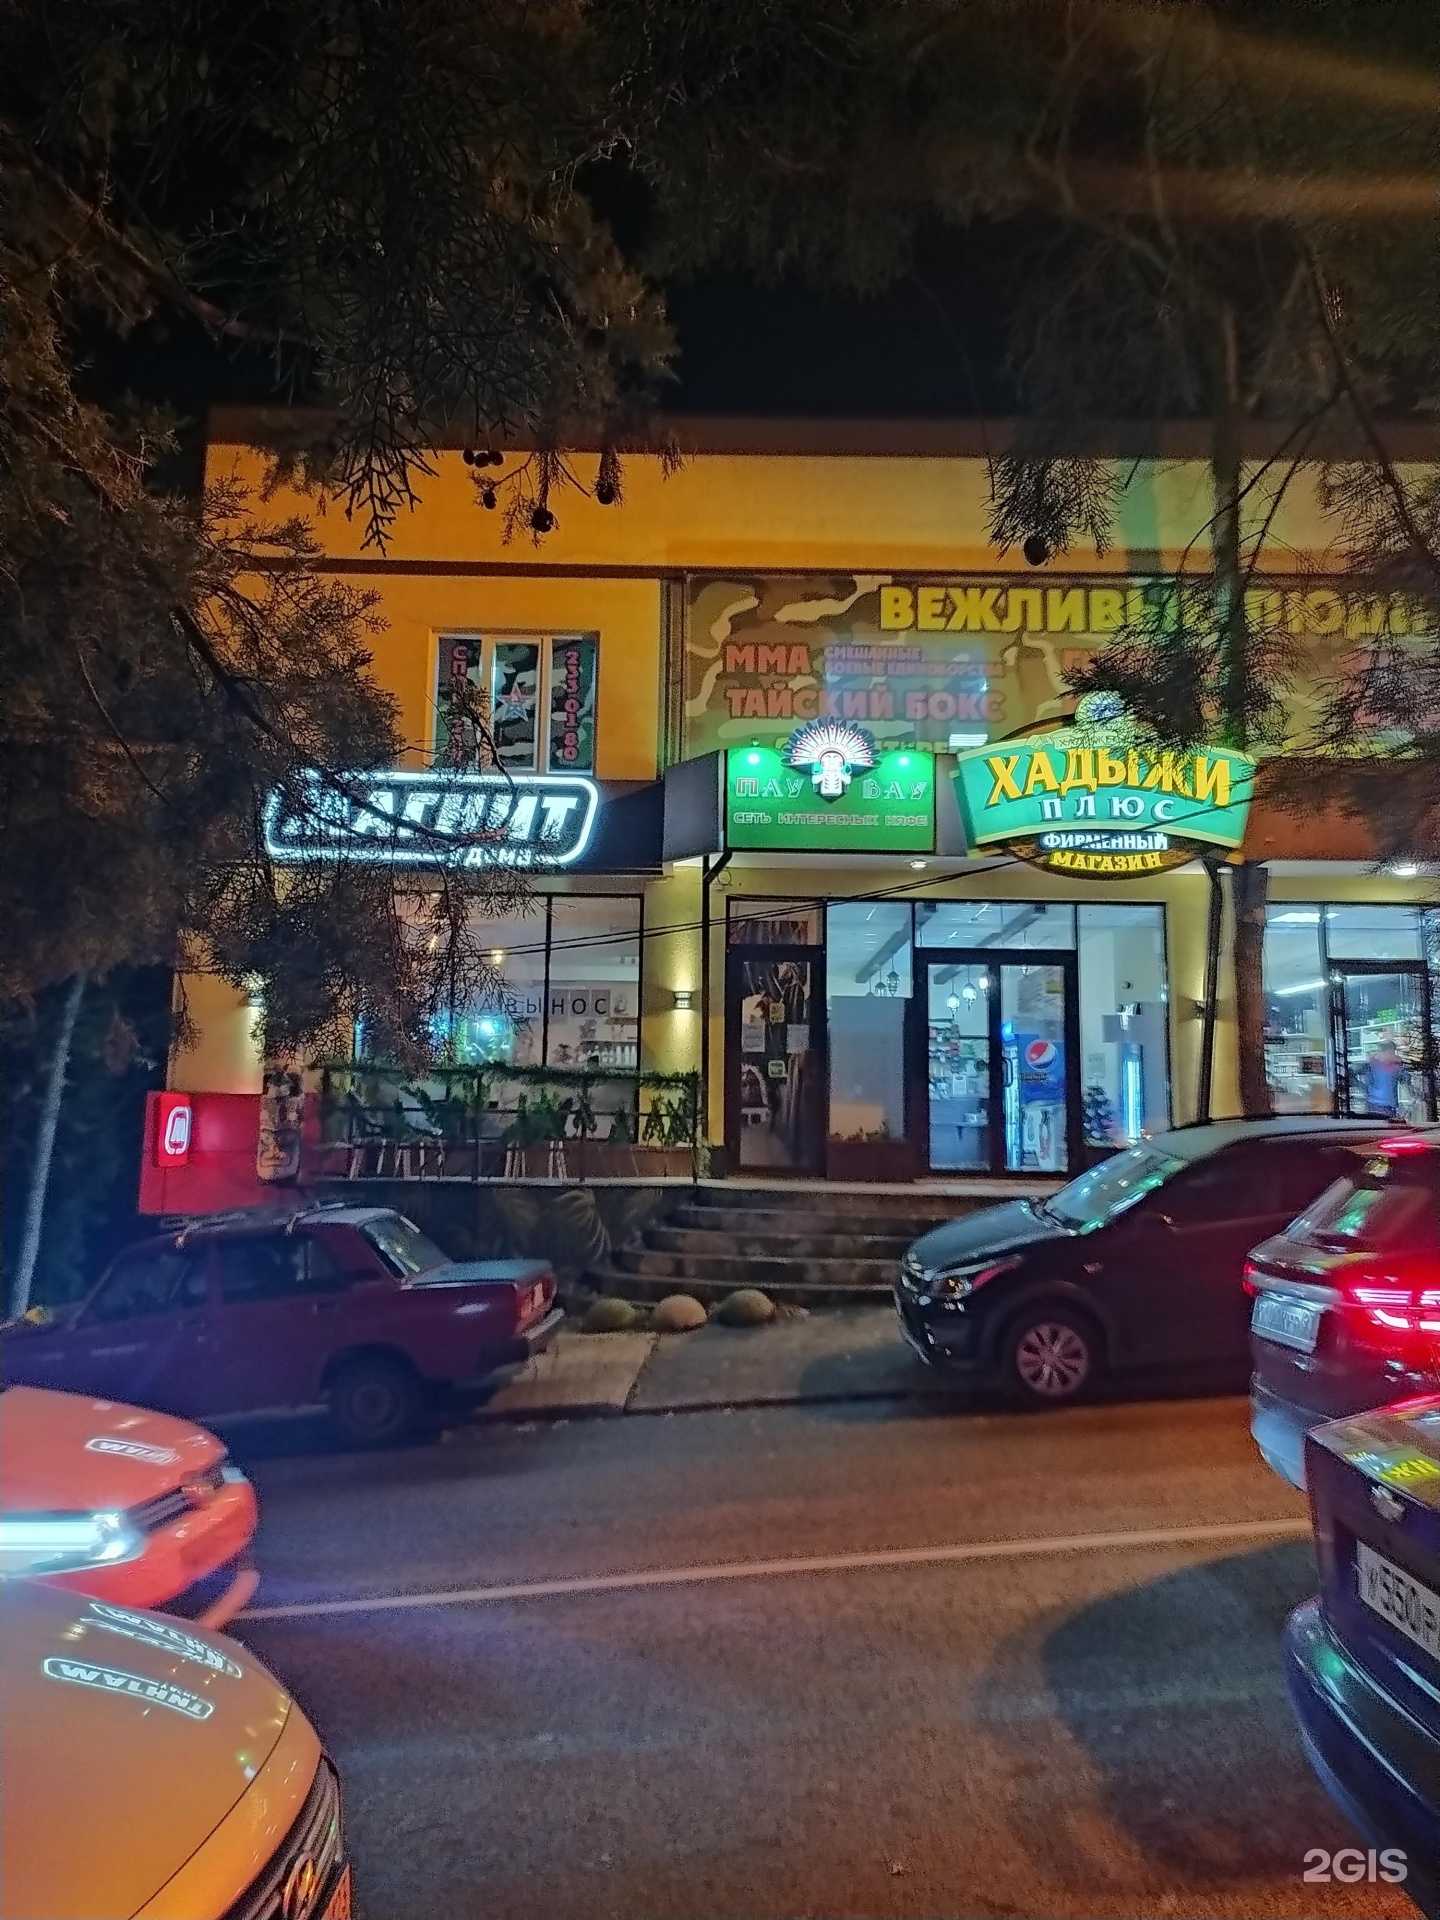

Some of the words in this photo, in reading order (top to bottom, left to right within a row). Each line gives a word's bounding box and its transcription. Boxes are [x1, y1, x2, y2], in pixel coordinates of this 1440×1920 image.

[880, 586, 1222, 634] ВЕЖЛИВЫ
[724, 645, 811, 674] ММА
[726, 682, 893, 719] ТАЙСКИЙ
[905, 690, 1005, 720] БОКС
[736, 777, 804, 797] ПАУ
[985, 747, 1231, 807] ХАДЫЖИ
[734, 812, 772, 825] СЕТЬ
[1040, 795, 1175, 822] ПЛЮС
[1050, 851, 1163, 873] МАГАЗИН
[506, 998, 609, 1015] ВЫНОС
